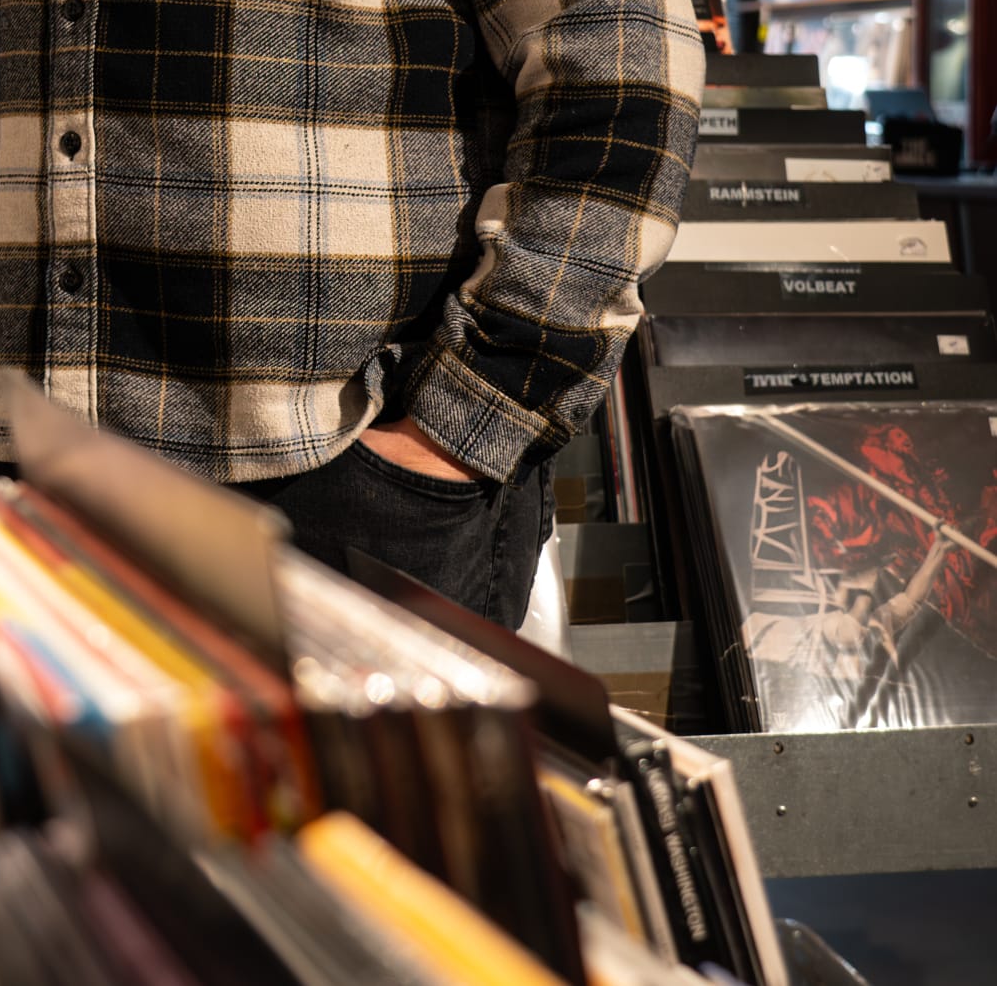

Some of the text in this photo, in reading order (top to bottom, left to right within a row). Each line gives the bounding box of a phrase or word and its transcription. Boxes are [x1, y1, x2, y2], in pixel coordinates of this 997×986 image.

[709, 187, 801, 202] RAMMSTEIN
[782, 279, 857, 295] VOLBEAT
[809, 371, 914, 388] TEMPTATION
[664, 830, 707, 943] WASHINGTON
